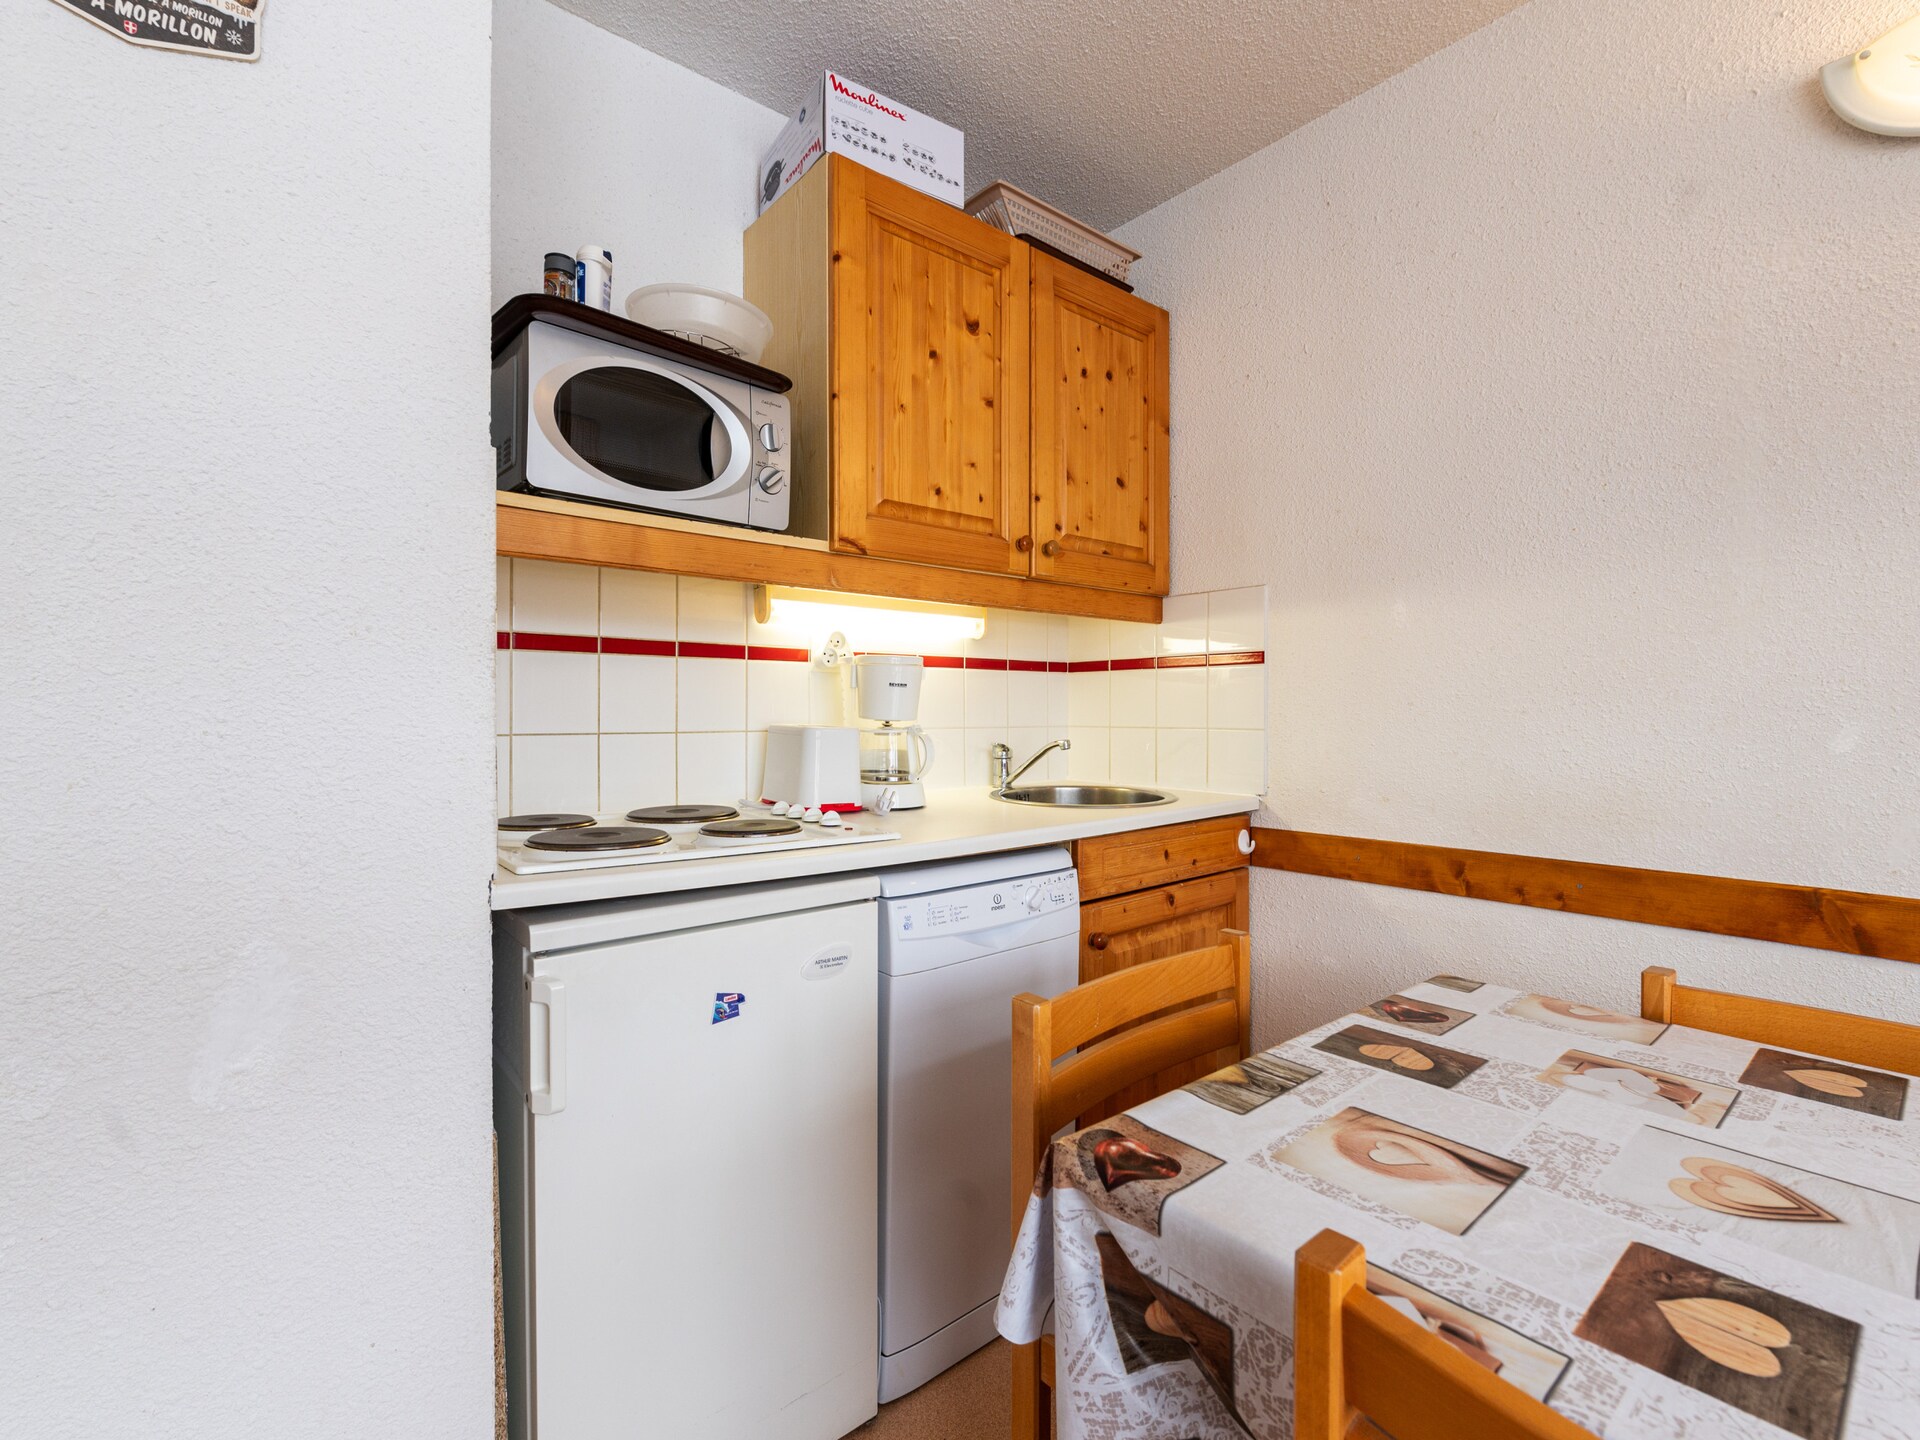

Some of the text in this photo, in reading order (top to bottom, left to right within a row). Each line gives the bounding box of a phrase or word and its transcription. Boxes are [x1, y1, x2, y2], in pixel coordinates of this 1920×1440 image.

[114, 0, 217, 45] MORILLON
[172, 1, 223, 28] MORILLON
[225, 1, 252, 18] SPEAK
[829, 74, 907, 121] Moulinex
